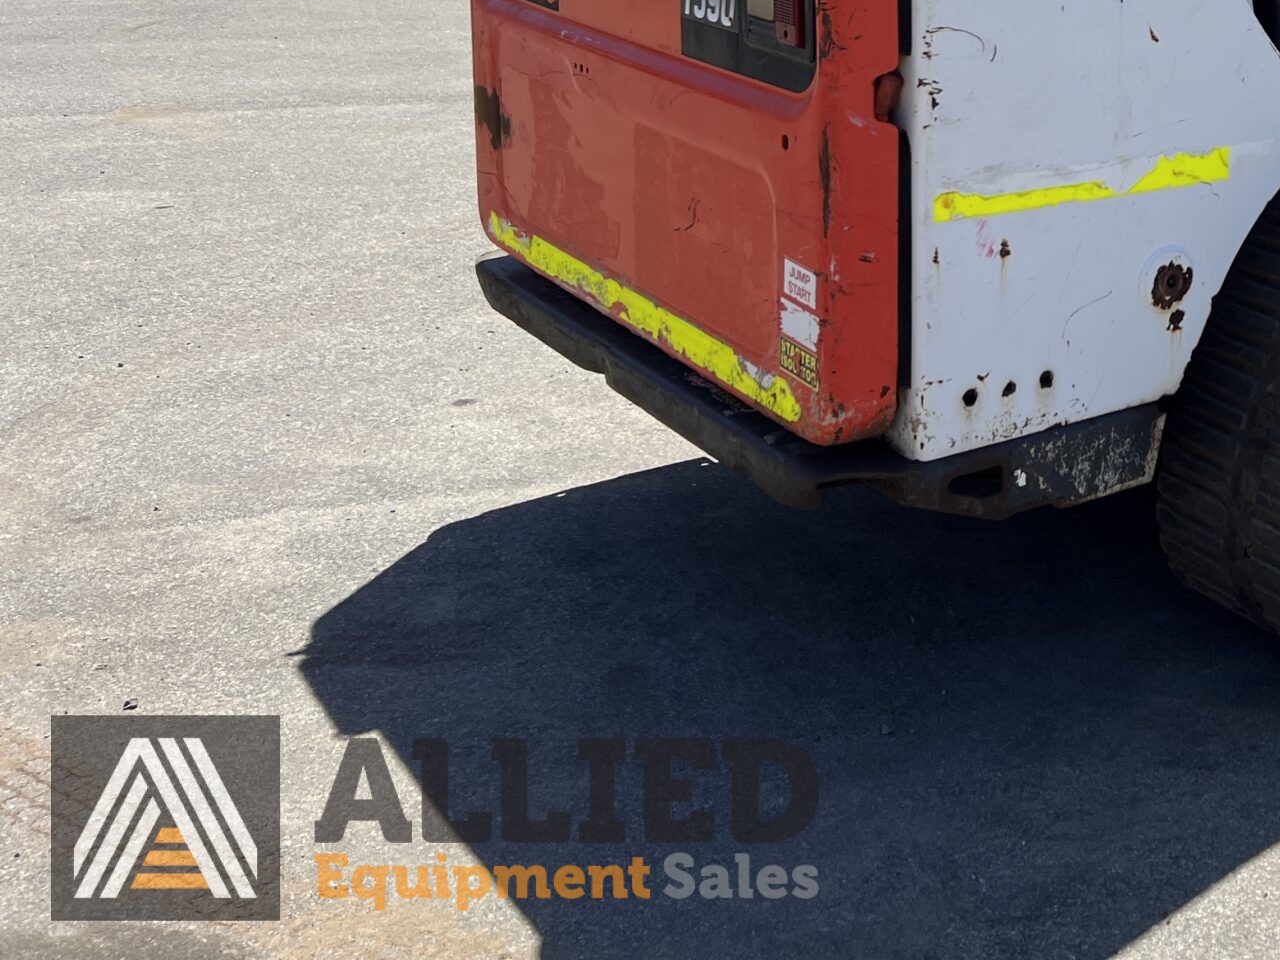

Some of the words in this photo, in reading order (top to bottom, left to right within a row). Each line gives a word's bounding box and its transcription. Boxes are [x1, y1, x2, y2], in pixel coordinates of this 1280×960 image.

[789, 266, 811, 286] JUMP
[788, 280, 812, 302] START
[781, 356, 817, 388] ISOLTOR
